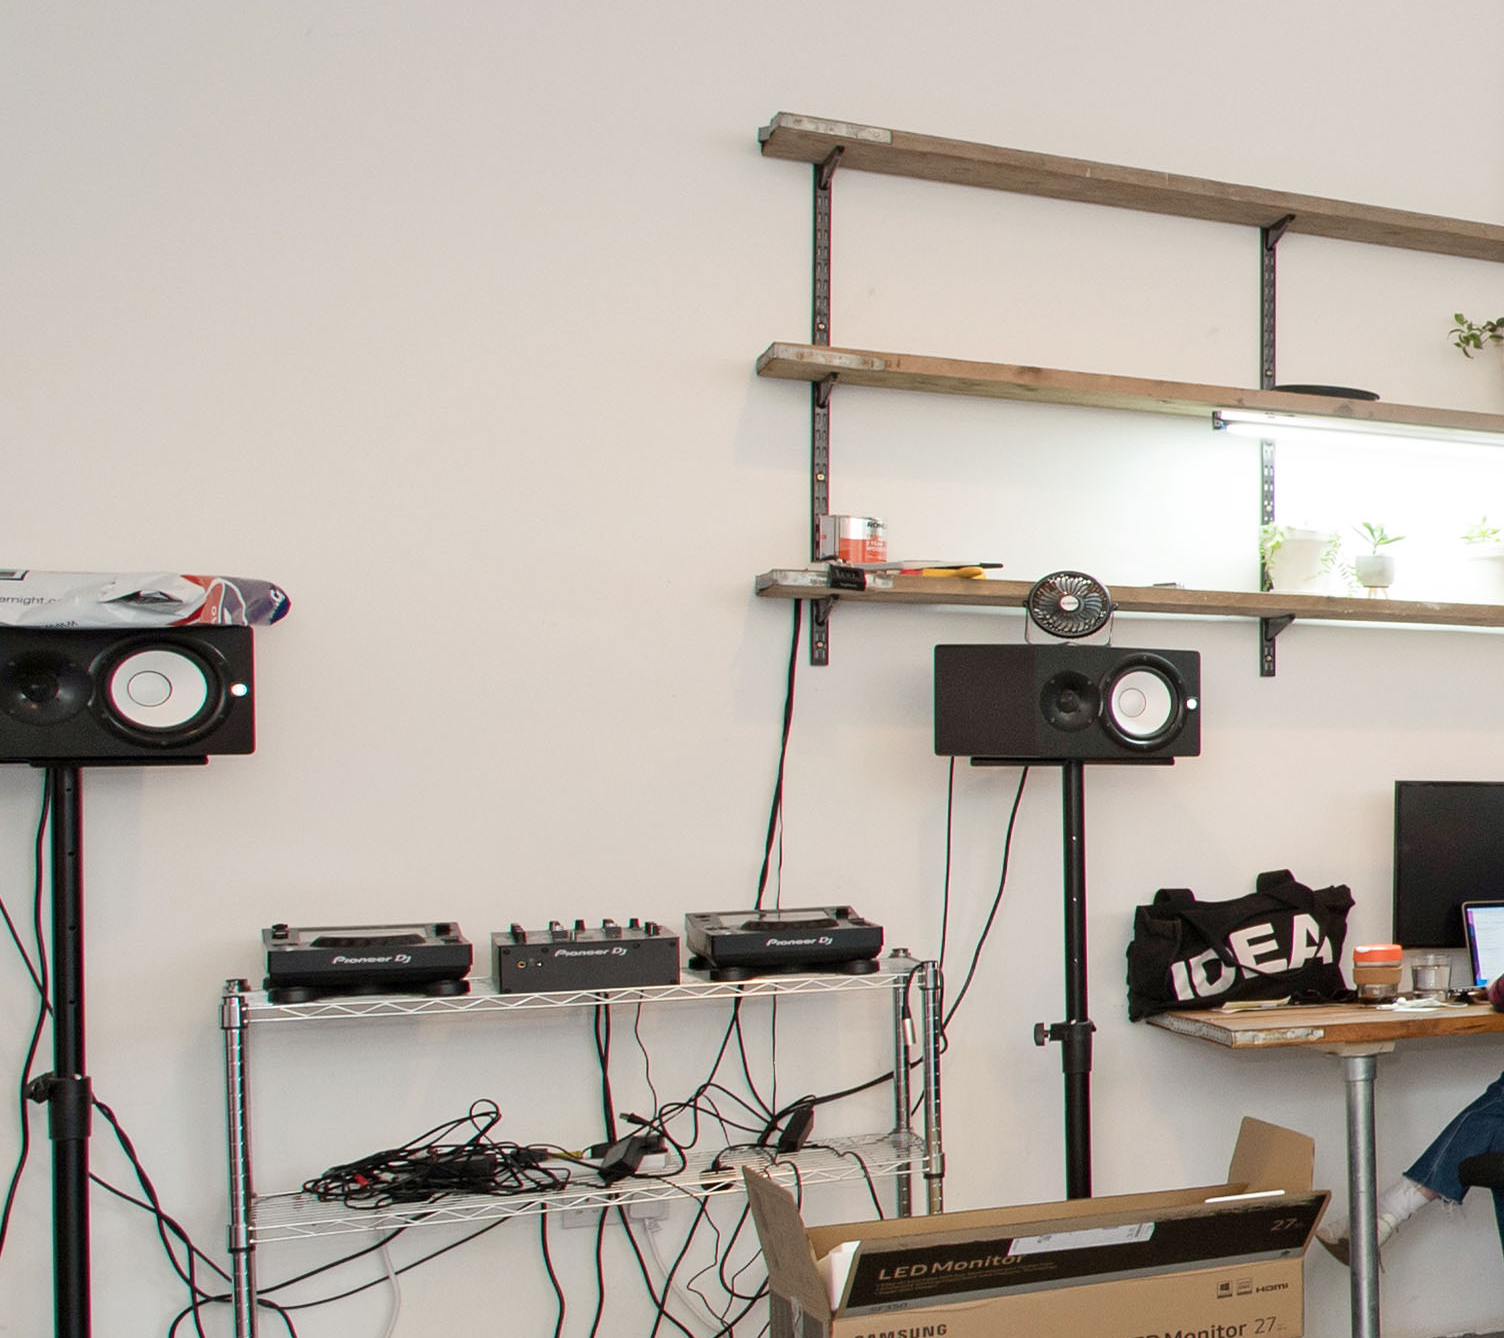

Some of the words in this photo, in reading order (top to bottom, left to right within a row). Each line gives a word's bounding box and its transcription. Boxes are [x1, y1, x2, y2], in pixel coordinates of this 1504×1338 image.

[766, 937, 816, 947] Pioneer
[554, 948, 610, 958] Pioneer
[1170, 913, 1334, 1001] IDEA
[332, 955, 392, 965] Pioneer
[878, 1263, 925, 1282] LED
[930, 1254, 1023, 1274] Monitor
[1256, 1282, 1289, 1294] HDMI
[1254, 1316, 1278, 1335] 27
